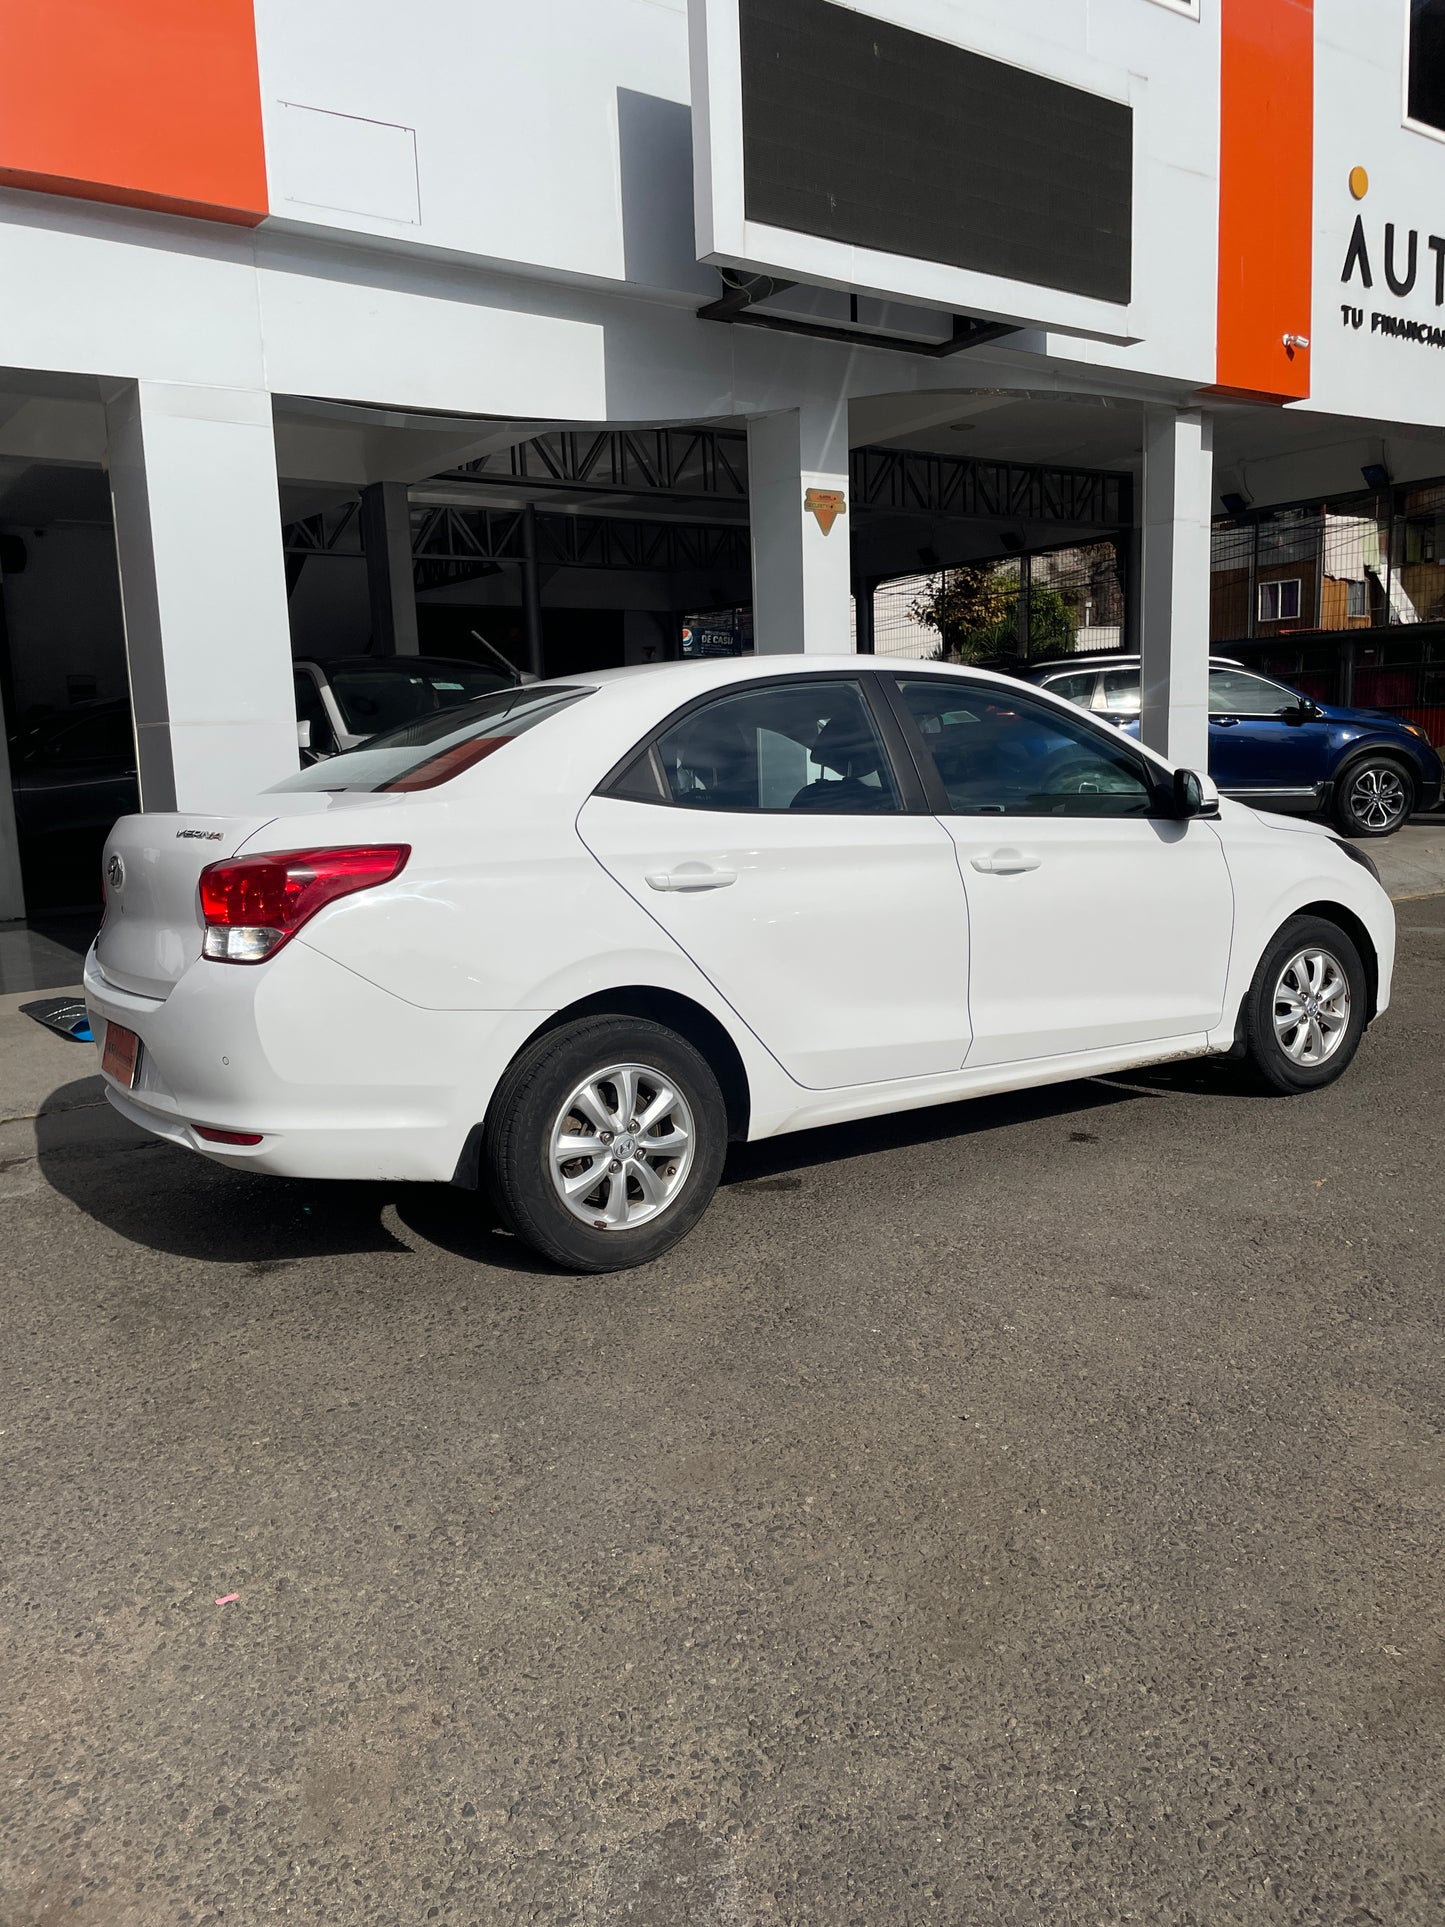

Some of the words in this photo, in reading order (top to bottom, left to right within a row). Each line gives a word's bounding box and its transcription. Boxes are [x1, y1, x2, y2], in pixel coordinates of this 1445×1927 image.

[1341, 305, 1363, 329] TU
[701, 634, 712, 644] DE
[176, 829, 224, 842] VERNA
